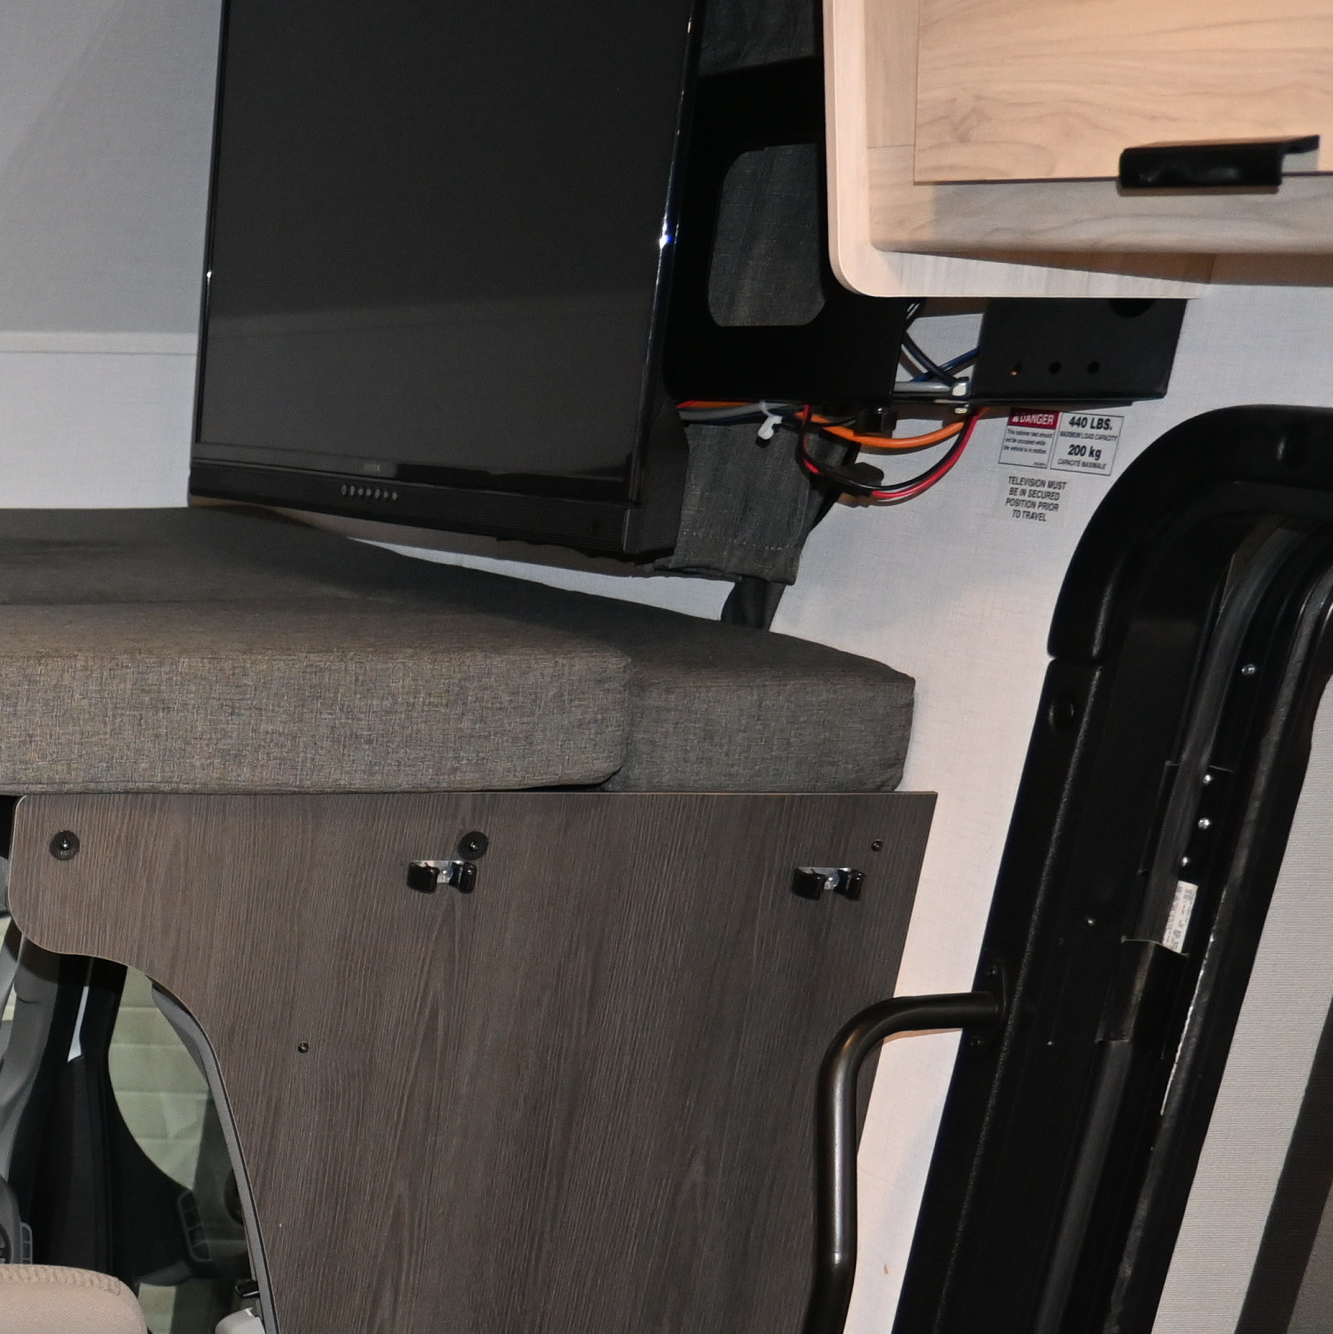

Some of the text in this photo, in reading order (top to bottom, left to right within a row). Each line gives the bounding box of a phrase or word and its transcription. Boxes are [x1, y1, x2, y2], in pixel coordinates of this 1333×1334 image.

[1019, 413, 1054, 426] DANGER
[1068, 415, 1113, 431] 440 LBS.
[1094, 433, 1118, 441] CAPACITY
[1067, 444, 1102, 461] 200 kg
[1008, 475, 1068, 490] TELEVISION MUST
[1008, 486, 1061, 501] BE IN SECURED
[1005, 497, 1060, 512] POSITION PRIOR
[1012, 509, 1047, 522] TO TRAVEL
